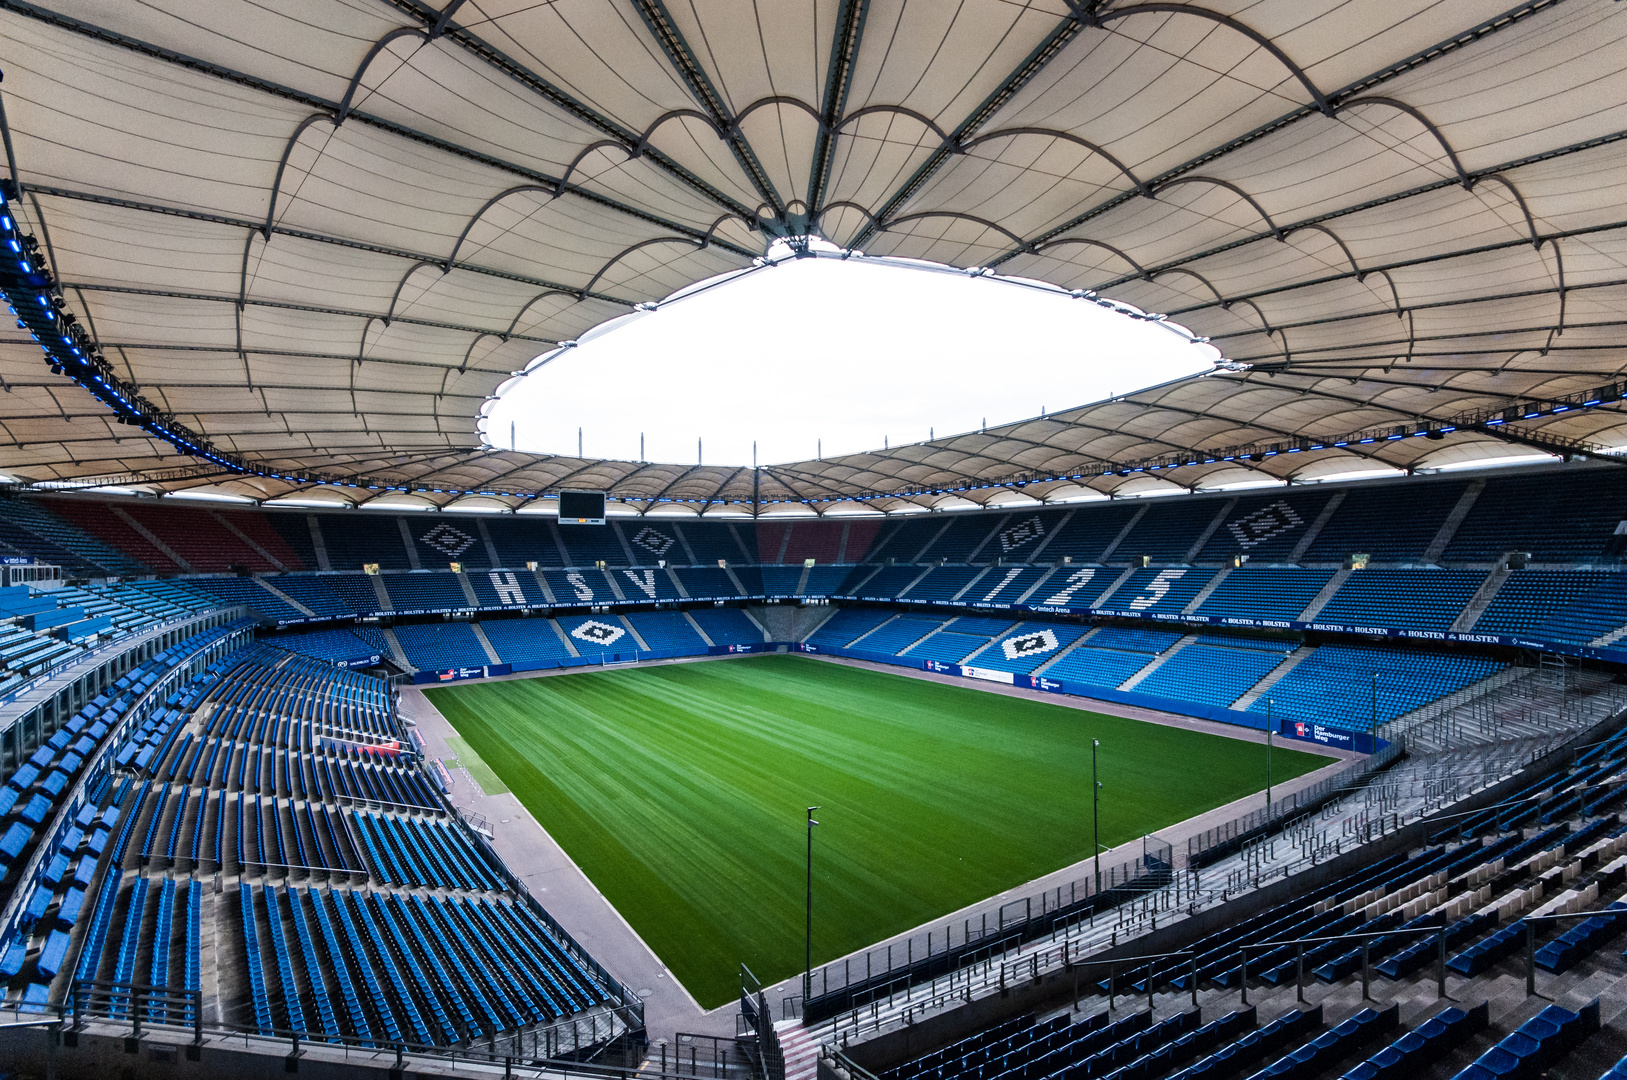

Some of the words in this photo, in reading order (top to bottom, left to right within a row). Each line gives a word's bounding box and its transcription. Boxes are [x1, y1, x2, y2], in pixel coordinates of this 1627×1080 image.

[1313, 624, 1344, 632] HOLSTEN
[1355, 626, 1388, 635] HOLSTEN
[1408, 630, 1445, 640] HOLSTEN
[1459, 634, 1499, 644] HOLSTEN
[1314, 730, 1350, 741] Hamburger
[1314, 734, 1328, 742] Weg
